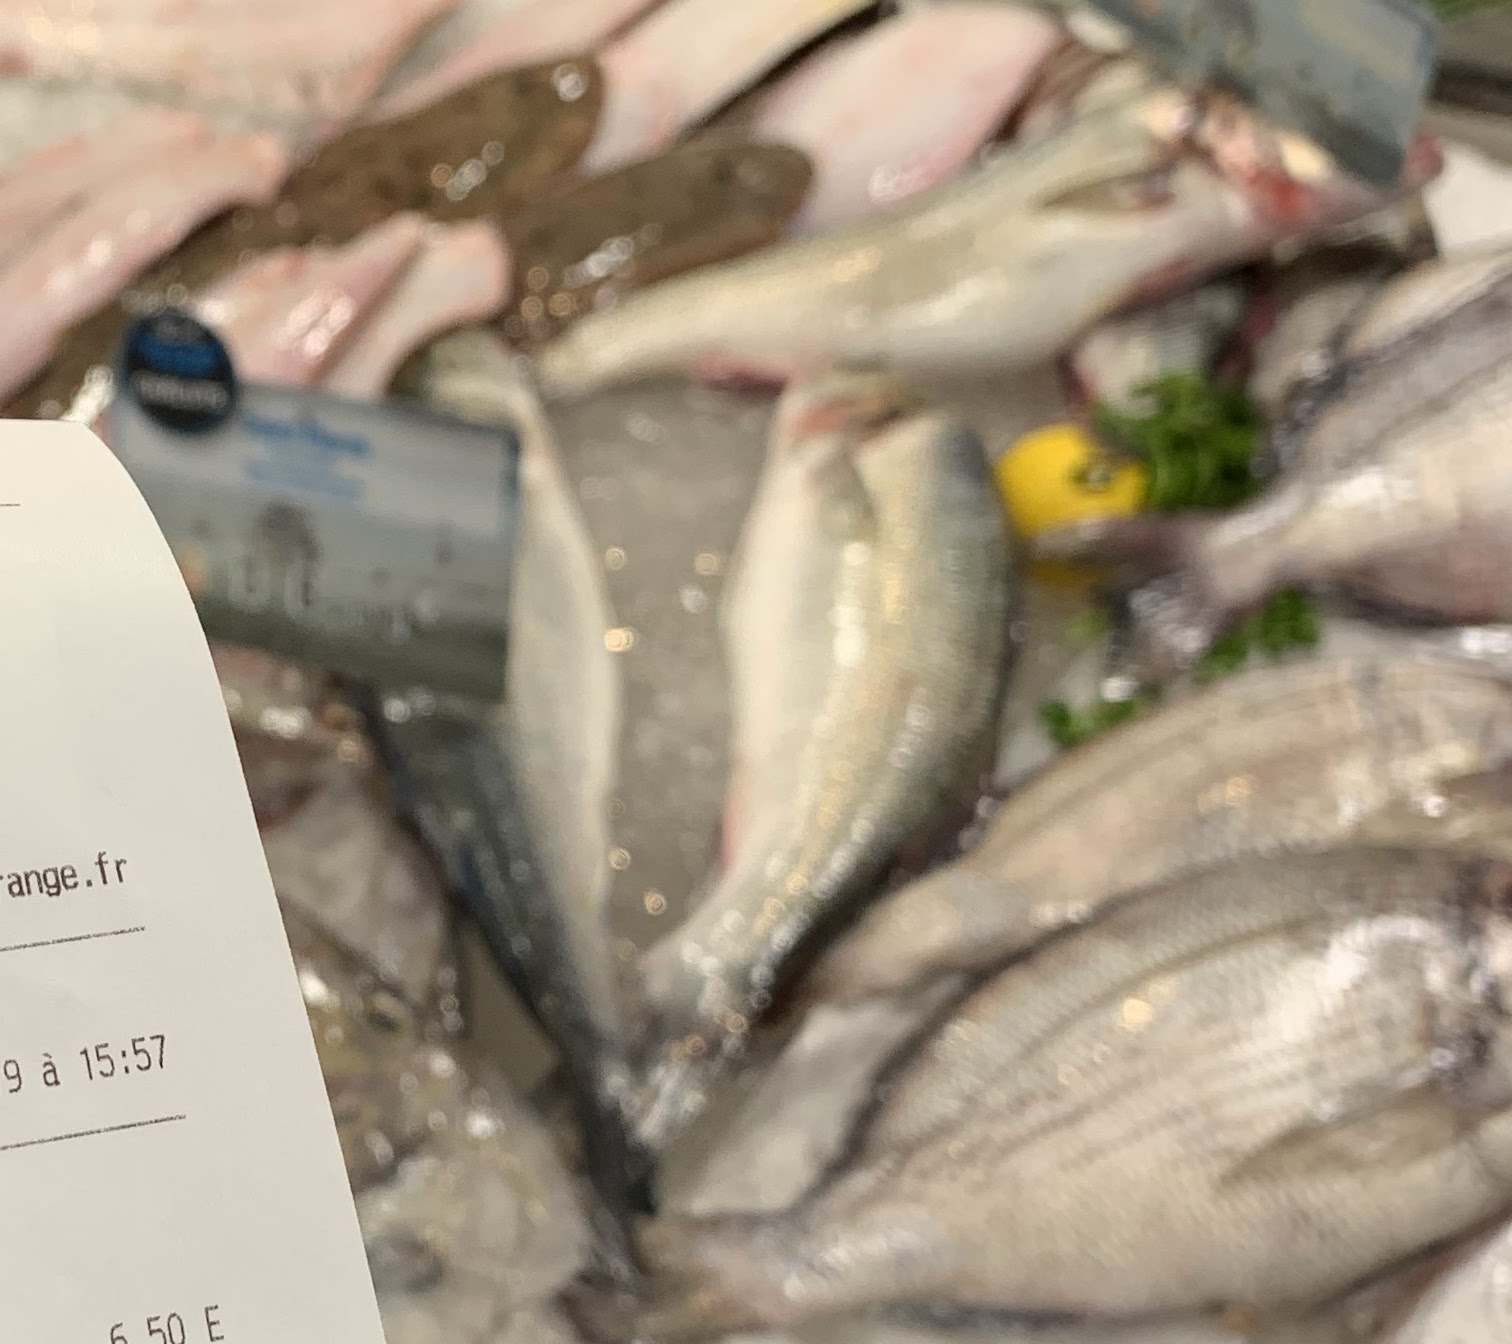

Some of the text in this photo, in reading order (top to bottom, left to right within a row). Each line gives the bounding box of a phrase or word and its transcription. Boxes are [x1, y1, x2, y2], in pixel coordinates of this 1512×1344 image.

[41, 1052, 61, 1088] à
[79, 1033, 166, 1081] 15:57
[203, 1303, 225, 1343] E
